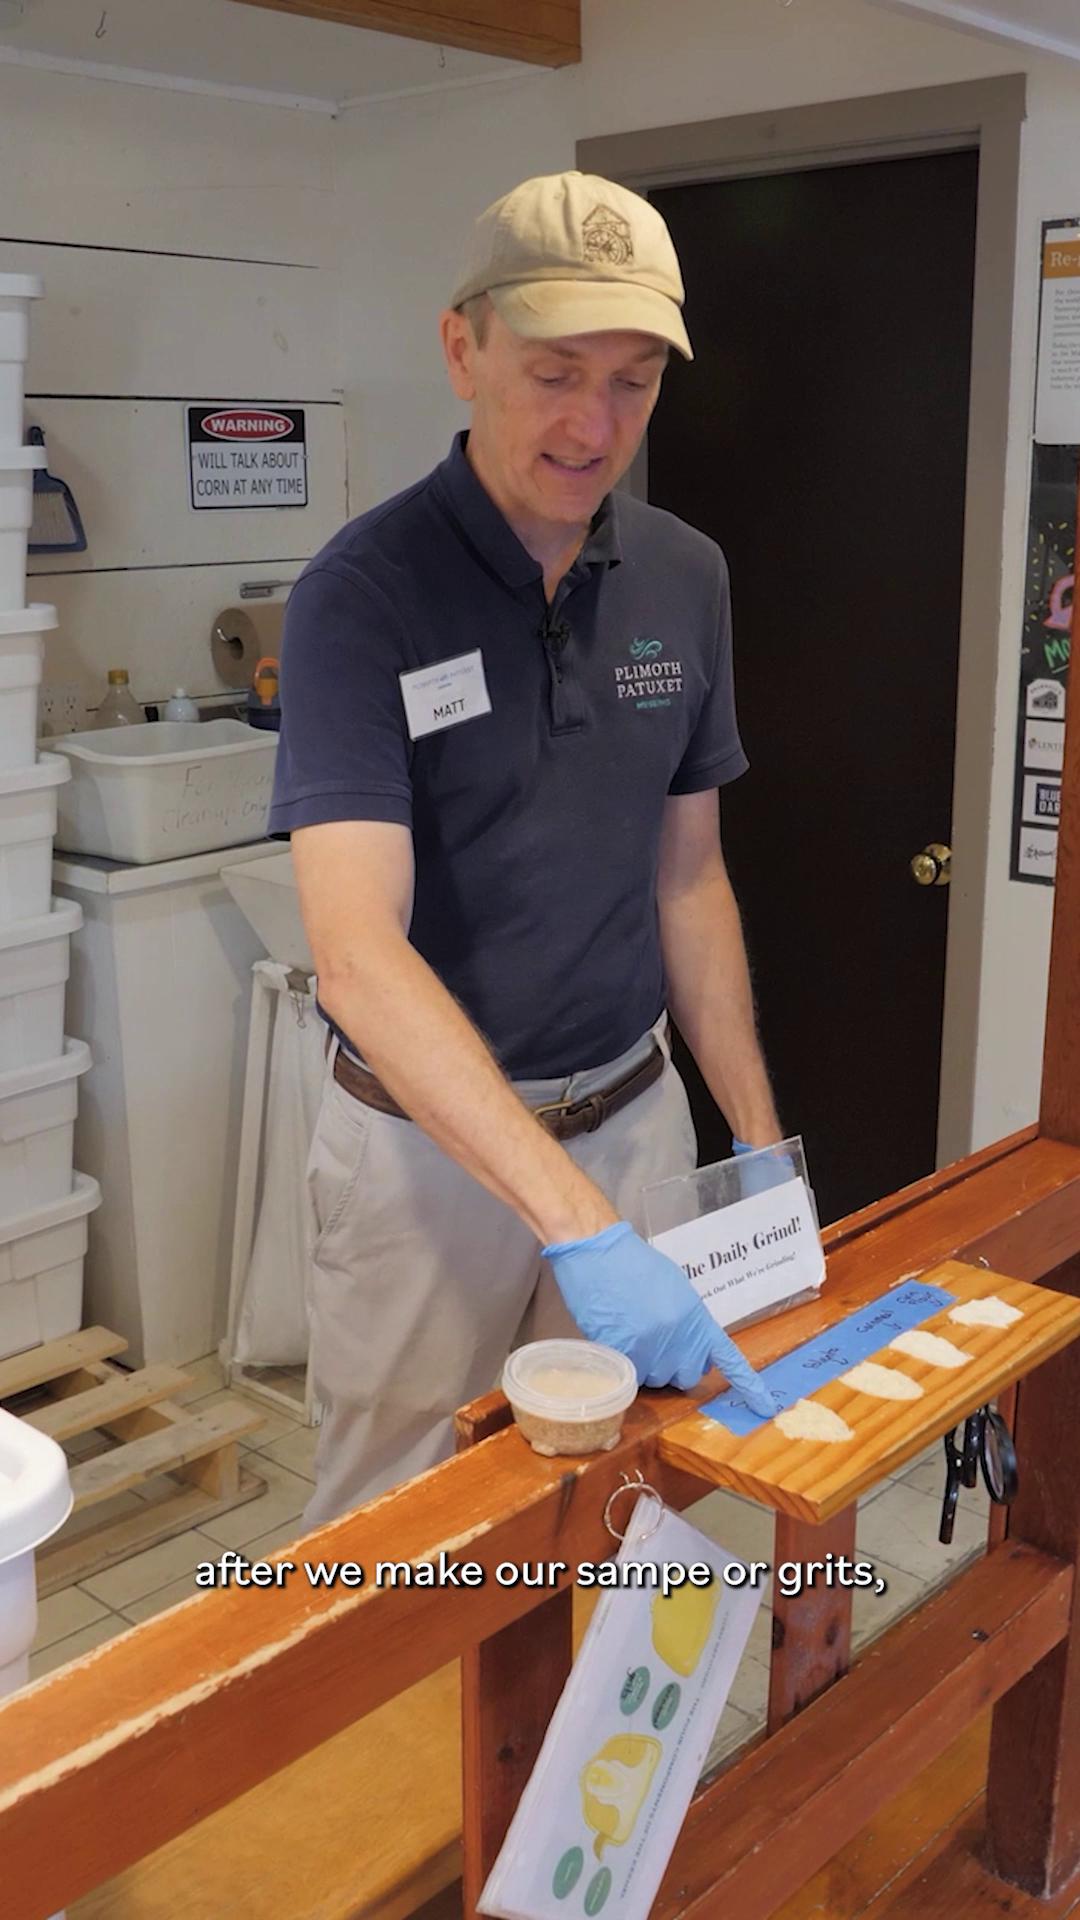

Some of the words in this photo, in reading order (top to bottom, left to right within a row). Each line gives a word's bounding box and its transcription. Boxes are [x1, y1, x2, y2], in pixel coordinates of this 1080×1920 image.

[1051, 251, 1080, 268] Re-
[211, 418, 286, 432] WARNING
[198, 453, 228, 469] WILL
[230, 452, 258, 468] TALK
[262, 452, 299, 468] ABOUT
[196, 479, 230, 496] CORN
[233, 479, 247, 495] AT
[250, 479, 273, 495] ANY
[276, 478, 303, 494] TIME
[615, 662, 682, 681] PLIMOTH
[617, 678, 682, 698] PATUXET
[433, 698, 465, 720] MATT
[709, 1242, 748, 1270] Daily
[753, 1216, 802, 1250] Grind!
